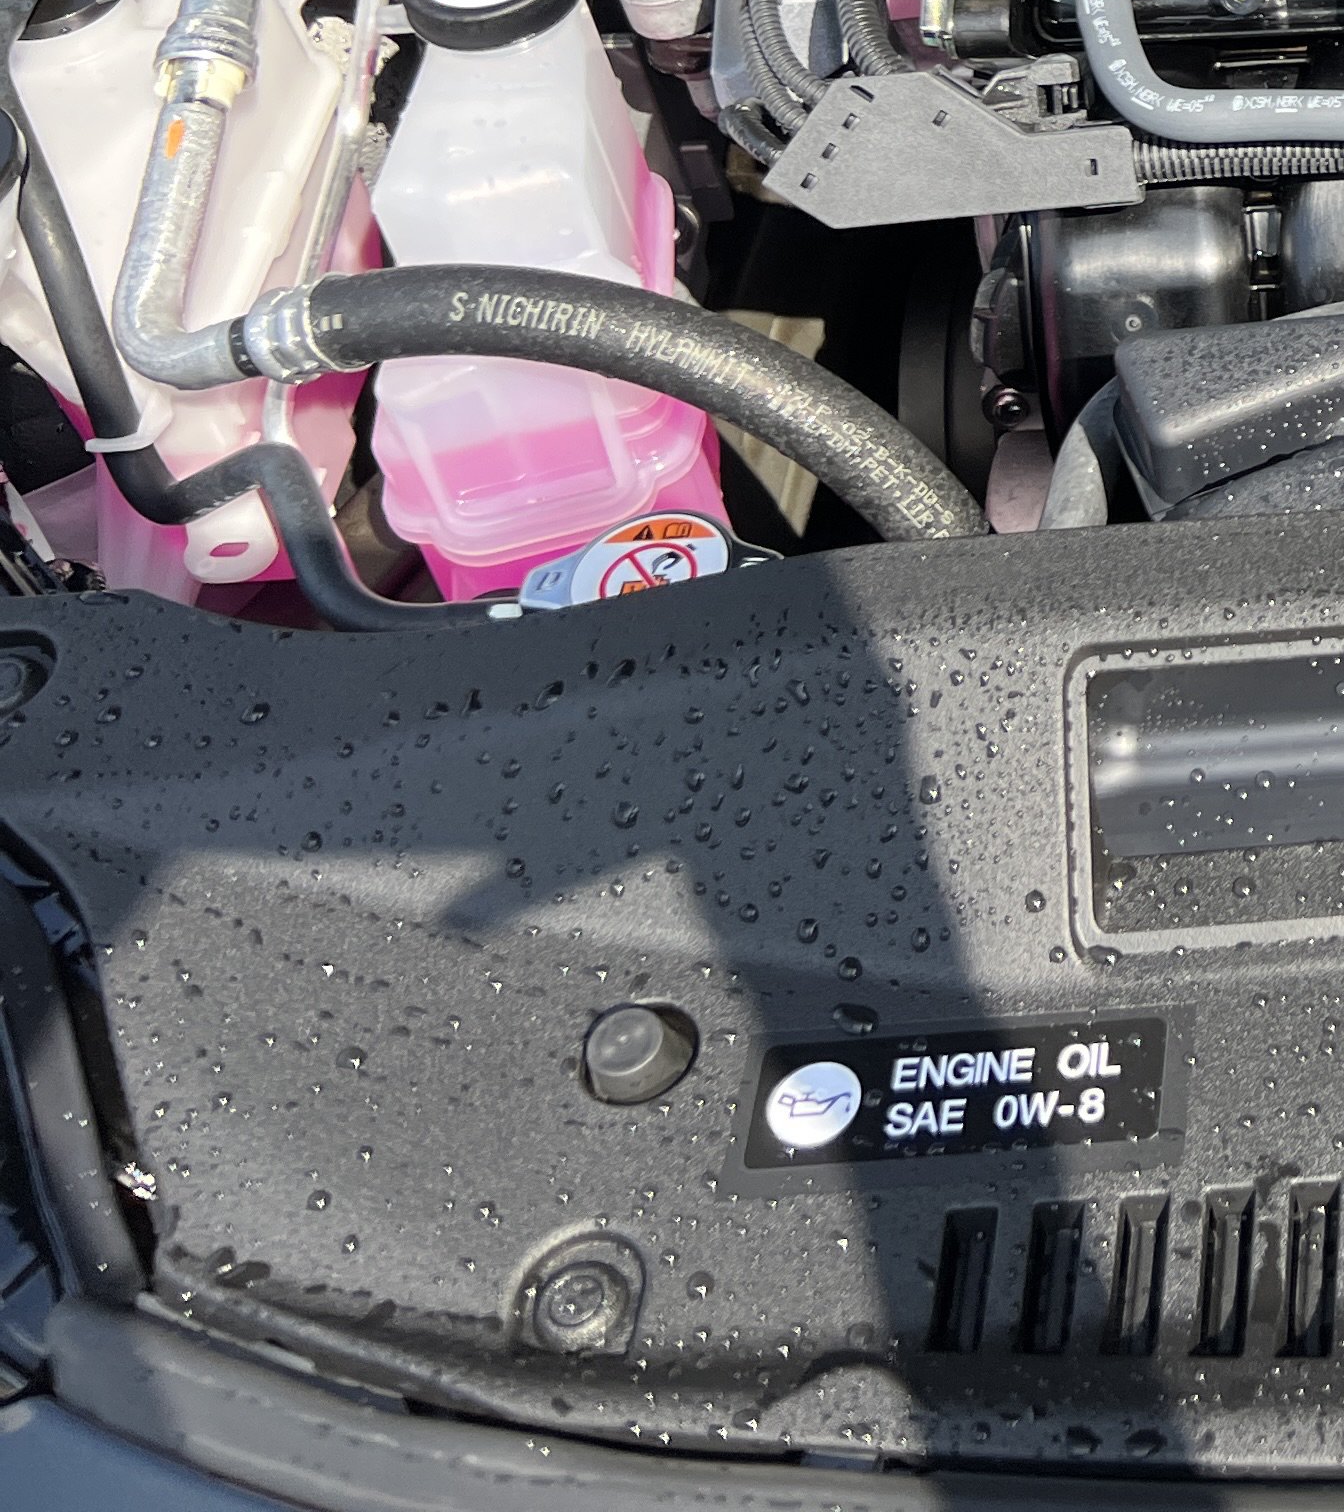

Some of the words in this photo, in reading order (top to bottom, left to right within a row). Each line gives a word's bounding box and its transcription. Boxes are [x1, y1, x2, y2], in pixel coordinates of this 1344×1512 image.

[892, 1047, 1036, 1091] ENGINE
[1057, 1041, 1122, 1079] OIL
[883, 1097, 967, 1138] SAE
[993, 1087, 1105, 1130] 0W-8
